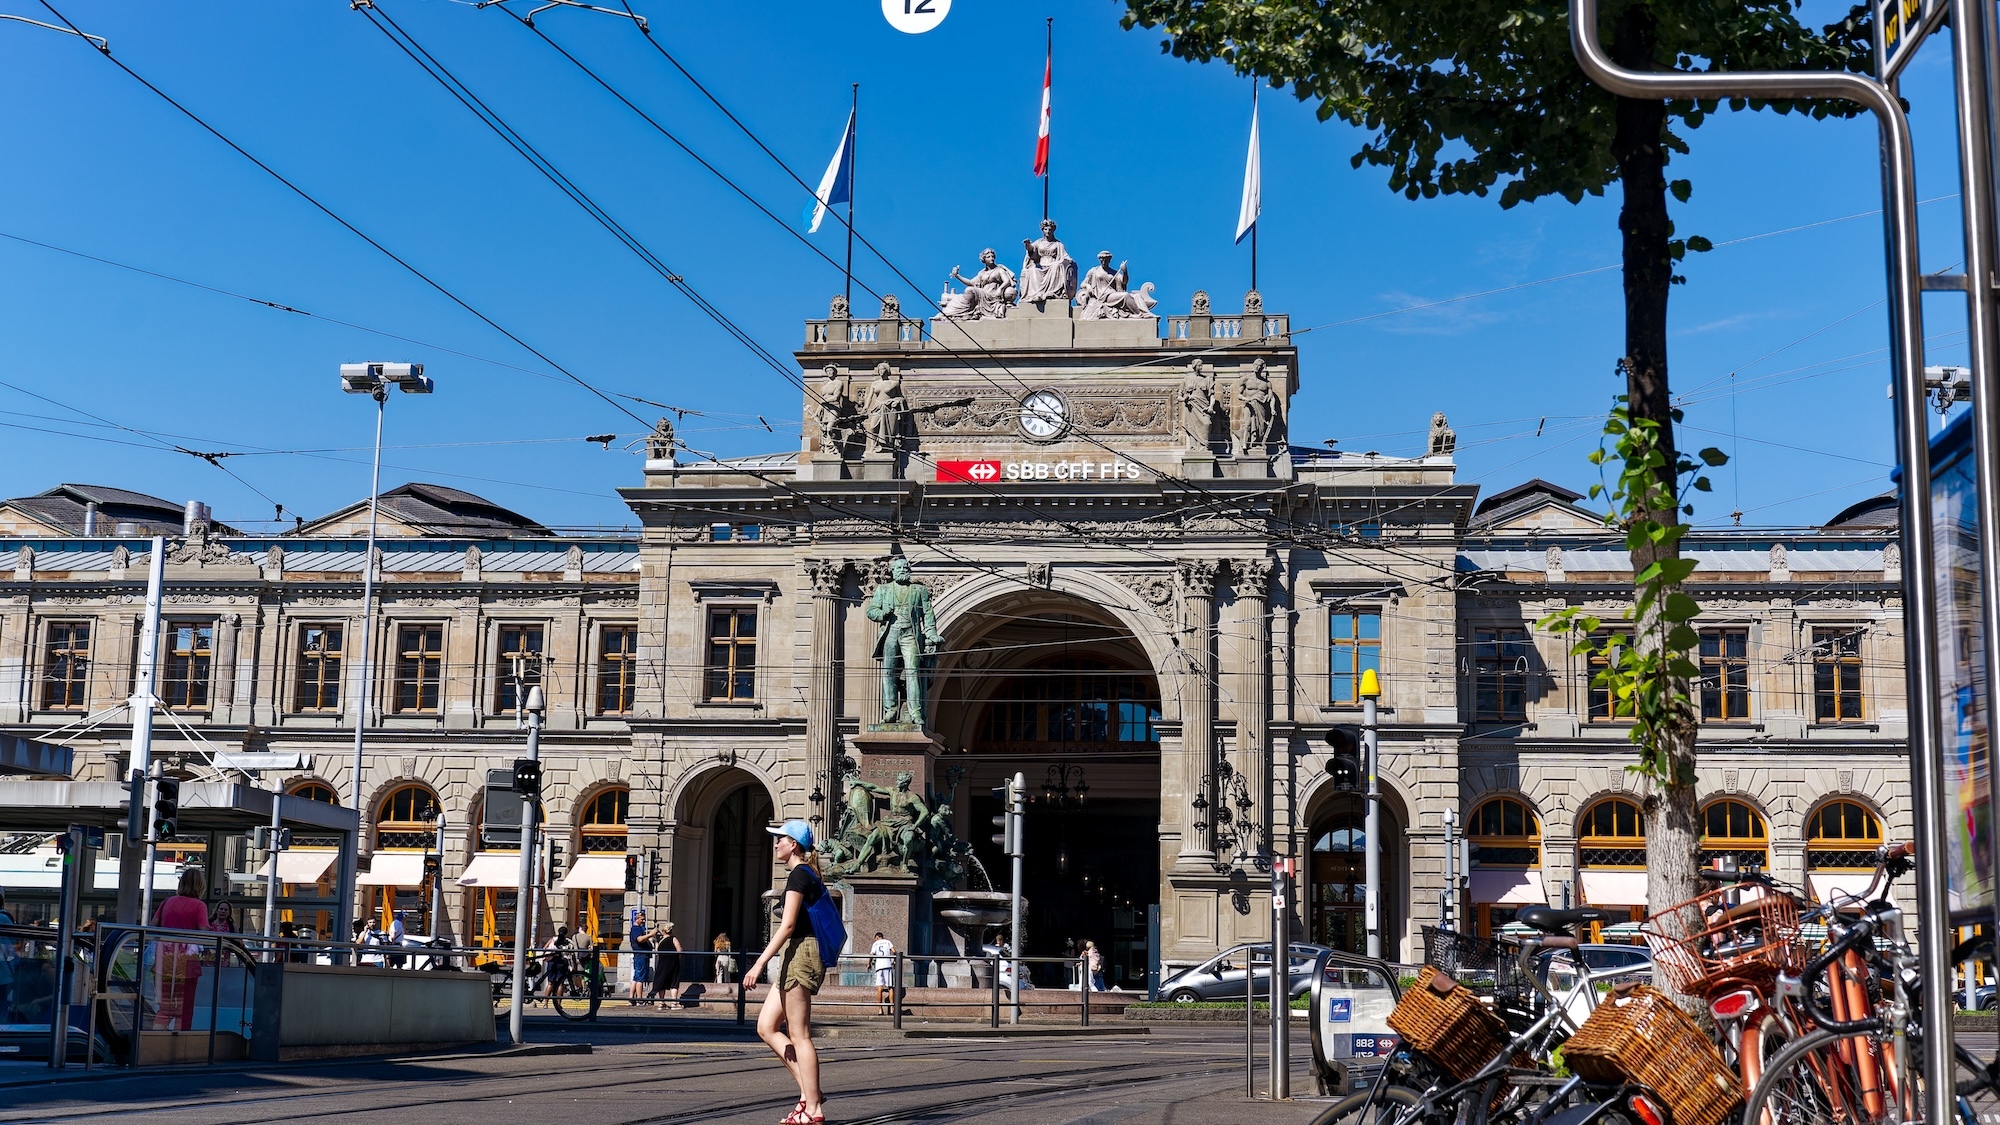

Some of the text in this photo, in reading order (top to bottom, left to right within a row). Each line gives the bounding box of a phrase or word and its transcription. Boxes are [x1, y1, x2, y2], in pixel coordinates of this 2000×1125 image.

[1006, 463, 1140, 479] SBB CFF FFS
[872, 758, 913, 766] ALFRED
